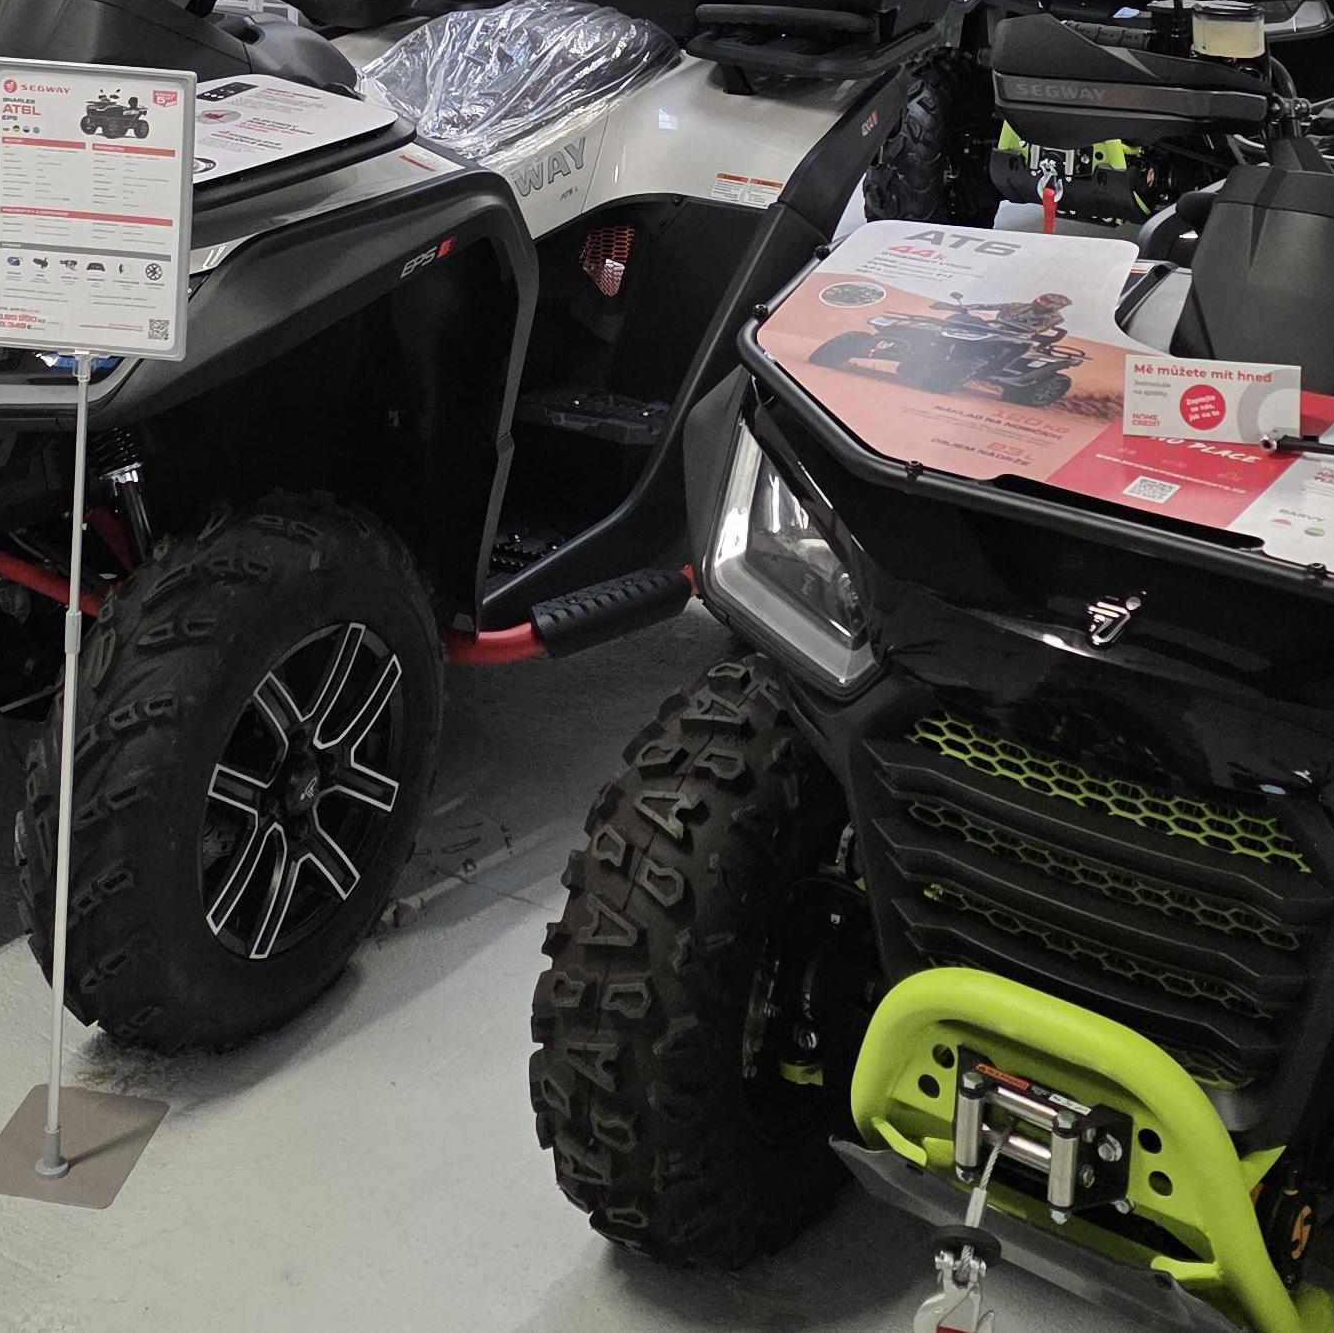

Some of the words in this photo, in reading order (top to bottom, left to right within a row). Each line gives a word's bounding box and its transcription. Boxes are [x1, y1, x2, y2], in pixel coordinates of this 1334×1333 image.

[20, 84, 71, 95] SEGWAY
[1014, 83, 1106, 101] SEGWAY
[2, 104, 42, 116] AT6L
[903, 229, 1022, 257] AT6
[400, 245, 438, 278] EPS
[1133, 363, 1154, 375] Mě
[1156, 364, 1207, 379] můžete
[1211, 367, 1234, 380] mít
[1132, 412, 1159, 421] HOME
[1187, 441, 1263, 463] PLACE
